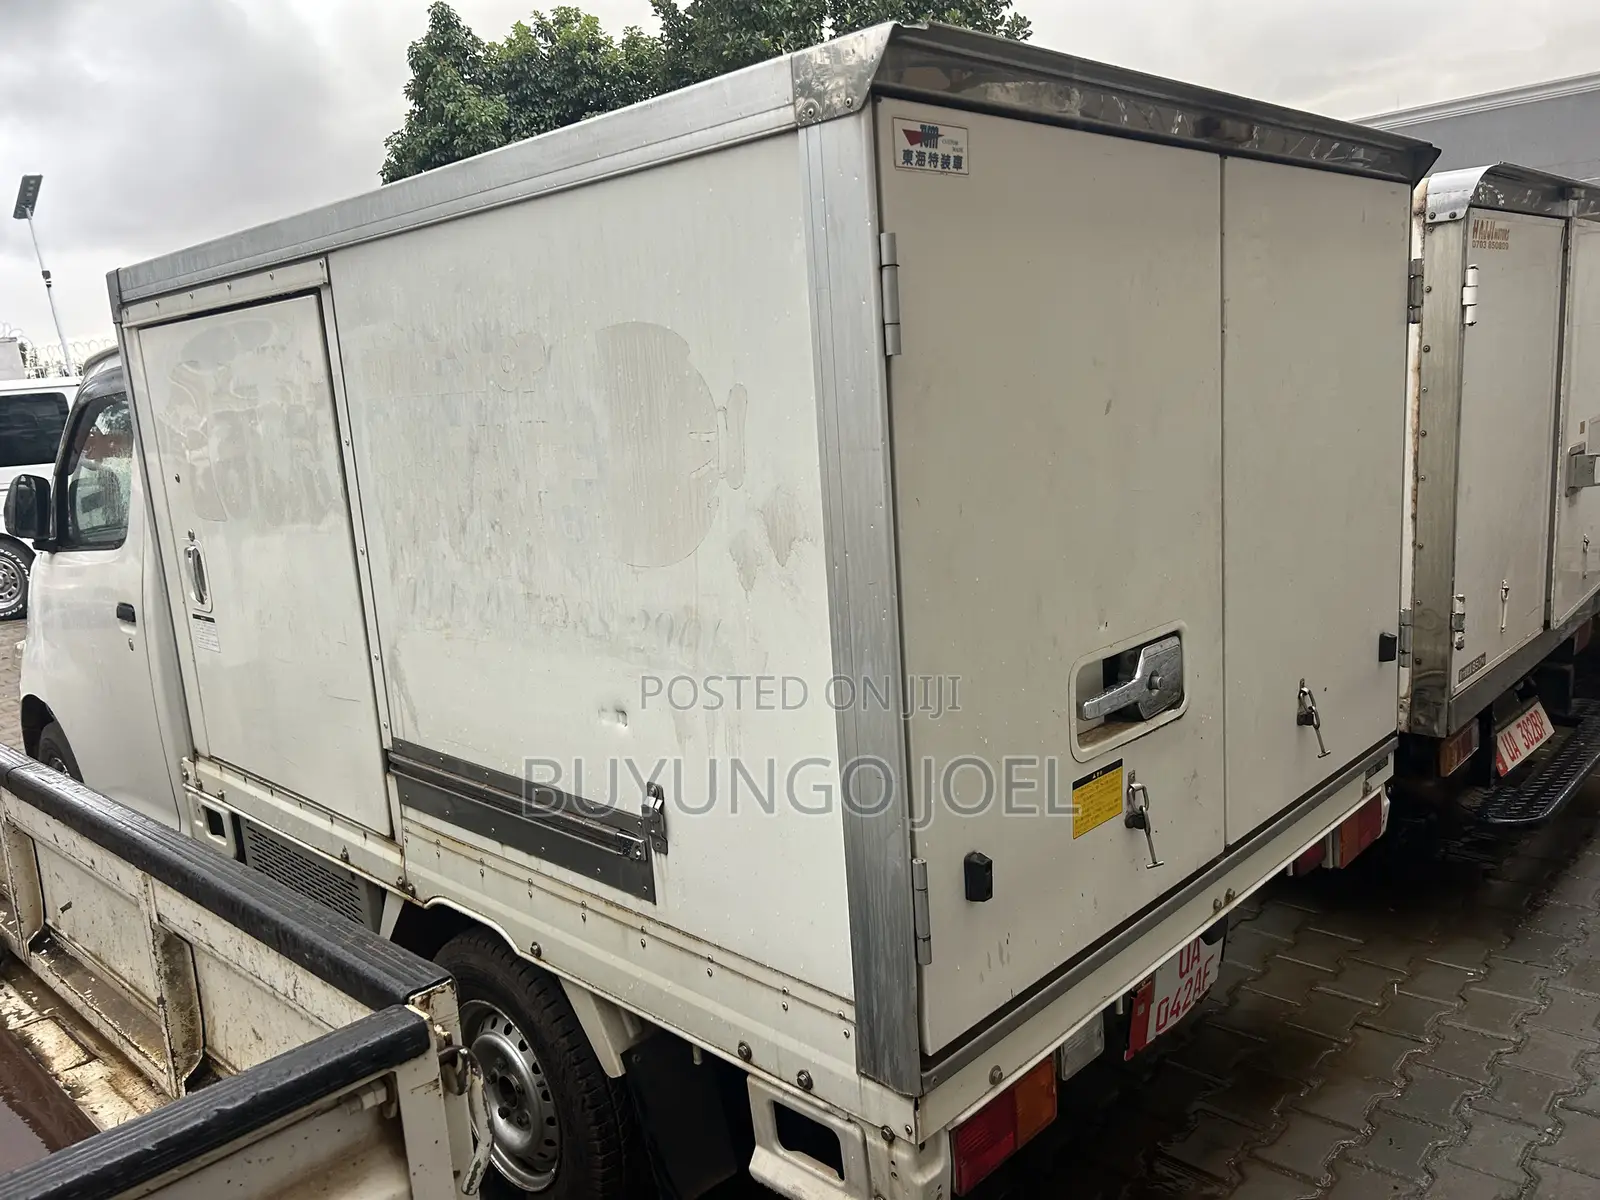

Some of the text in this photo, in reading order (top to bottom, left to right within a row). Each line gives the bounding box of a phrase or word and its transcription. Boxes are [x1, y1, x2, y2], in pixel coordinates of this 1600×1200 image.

[901, 148, 963, 171] 東海特装車
[1500, 709, 1547, 762] UA 382BP
[1178, 936, 1201, 979] UA
